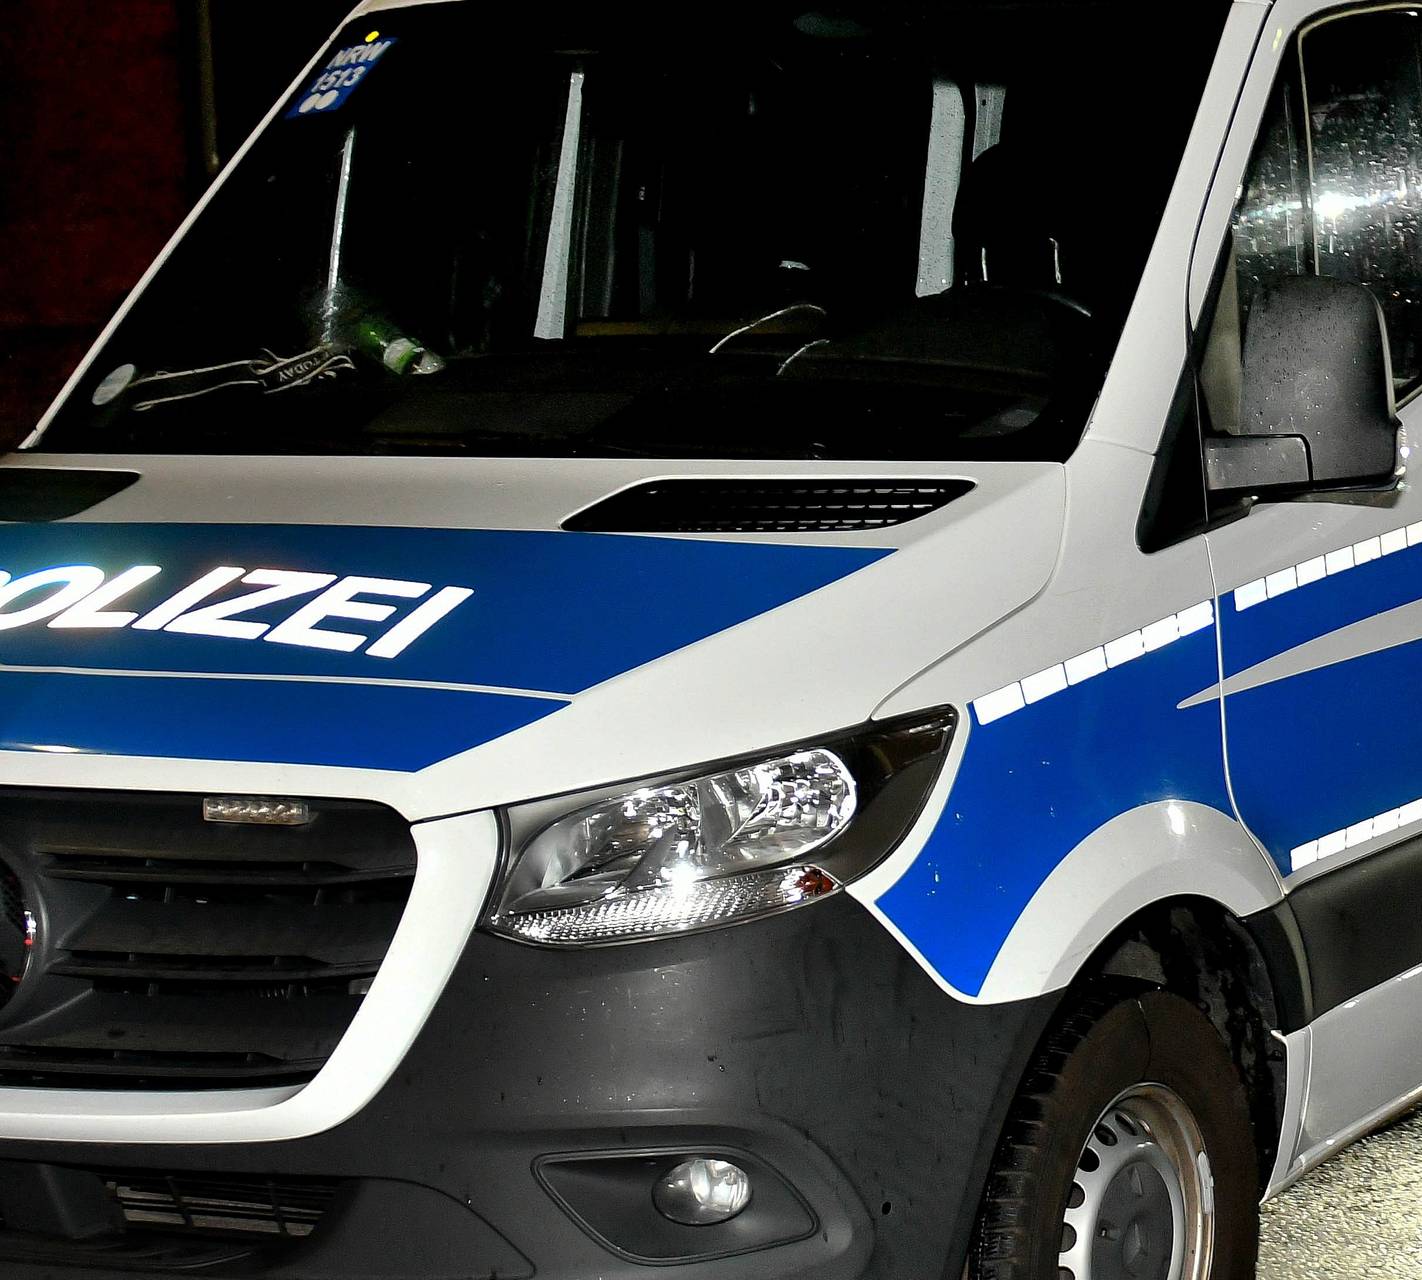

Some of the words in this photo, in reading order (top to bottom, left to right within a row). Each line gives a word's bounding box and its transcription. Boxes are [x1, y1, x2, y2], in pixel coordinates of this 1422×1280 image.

[326, 41, 392, 70] NRW
[311, 65, 366, 93] 1513
[0, 565, 474, 659] OLIZEI
